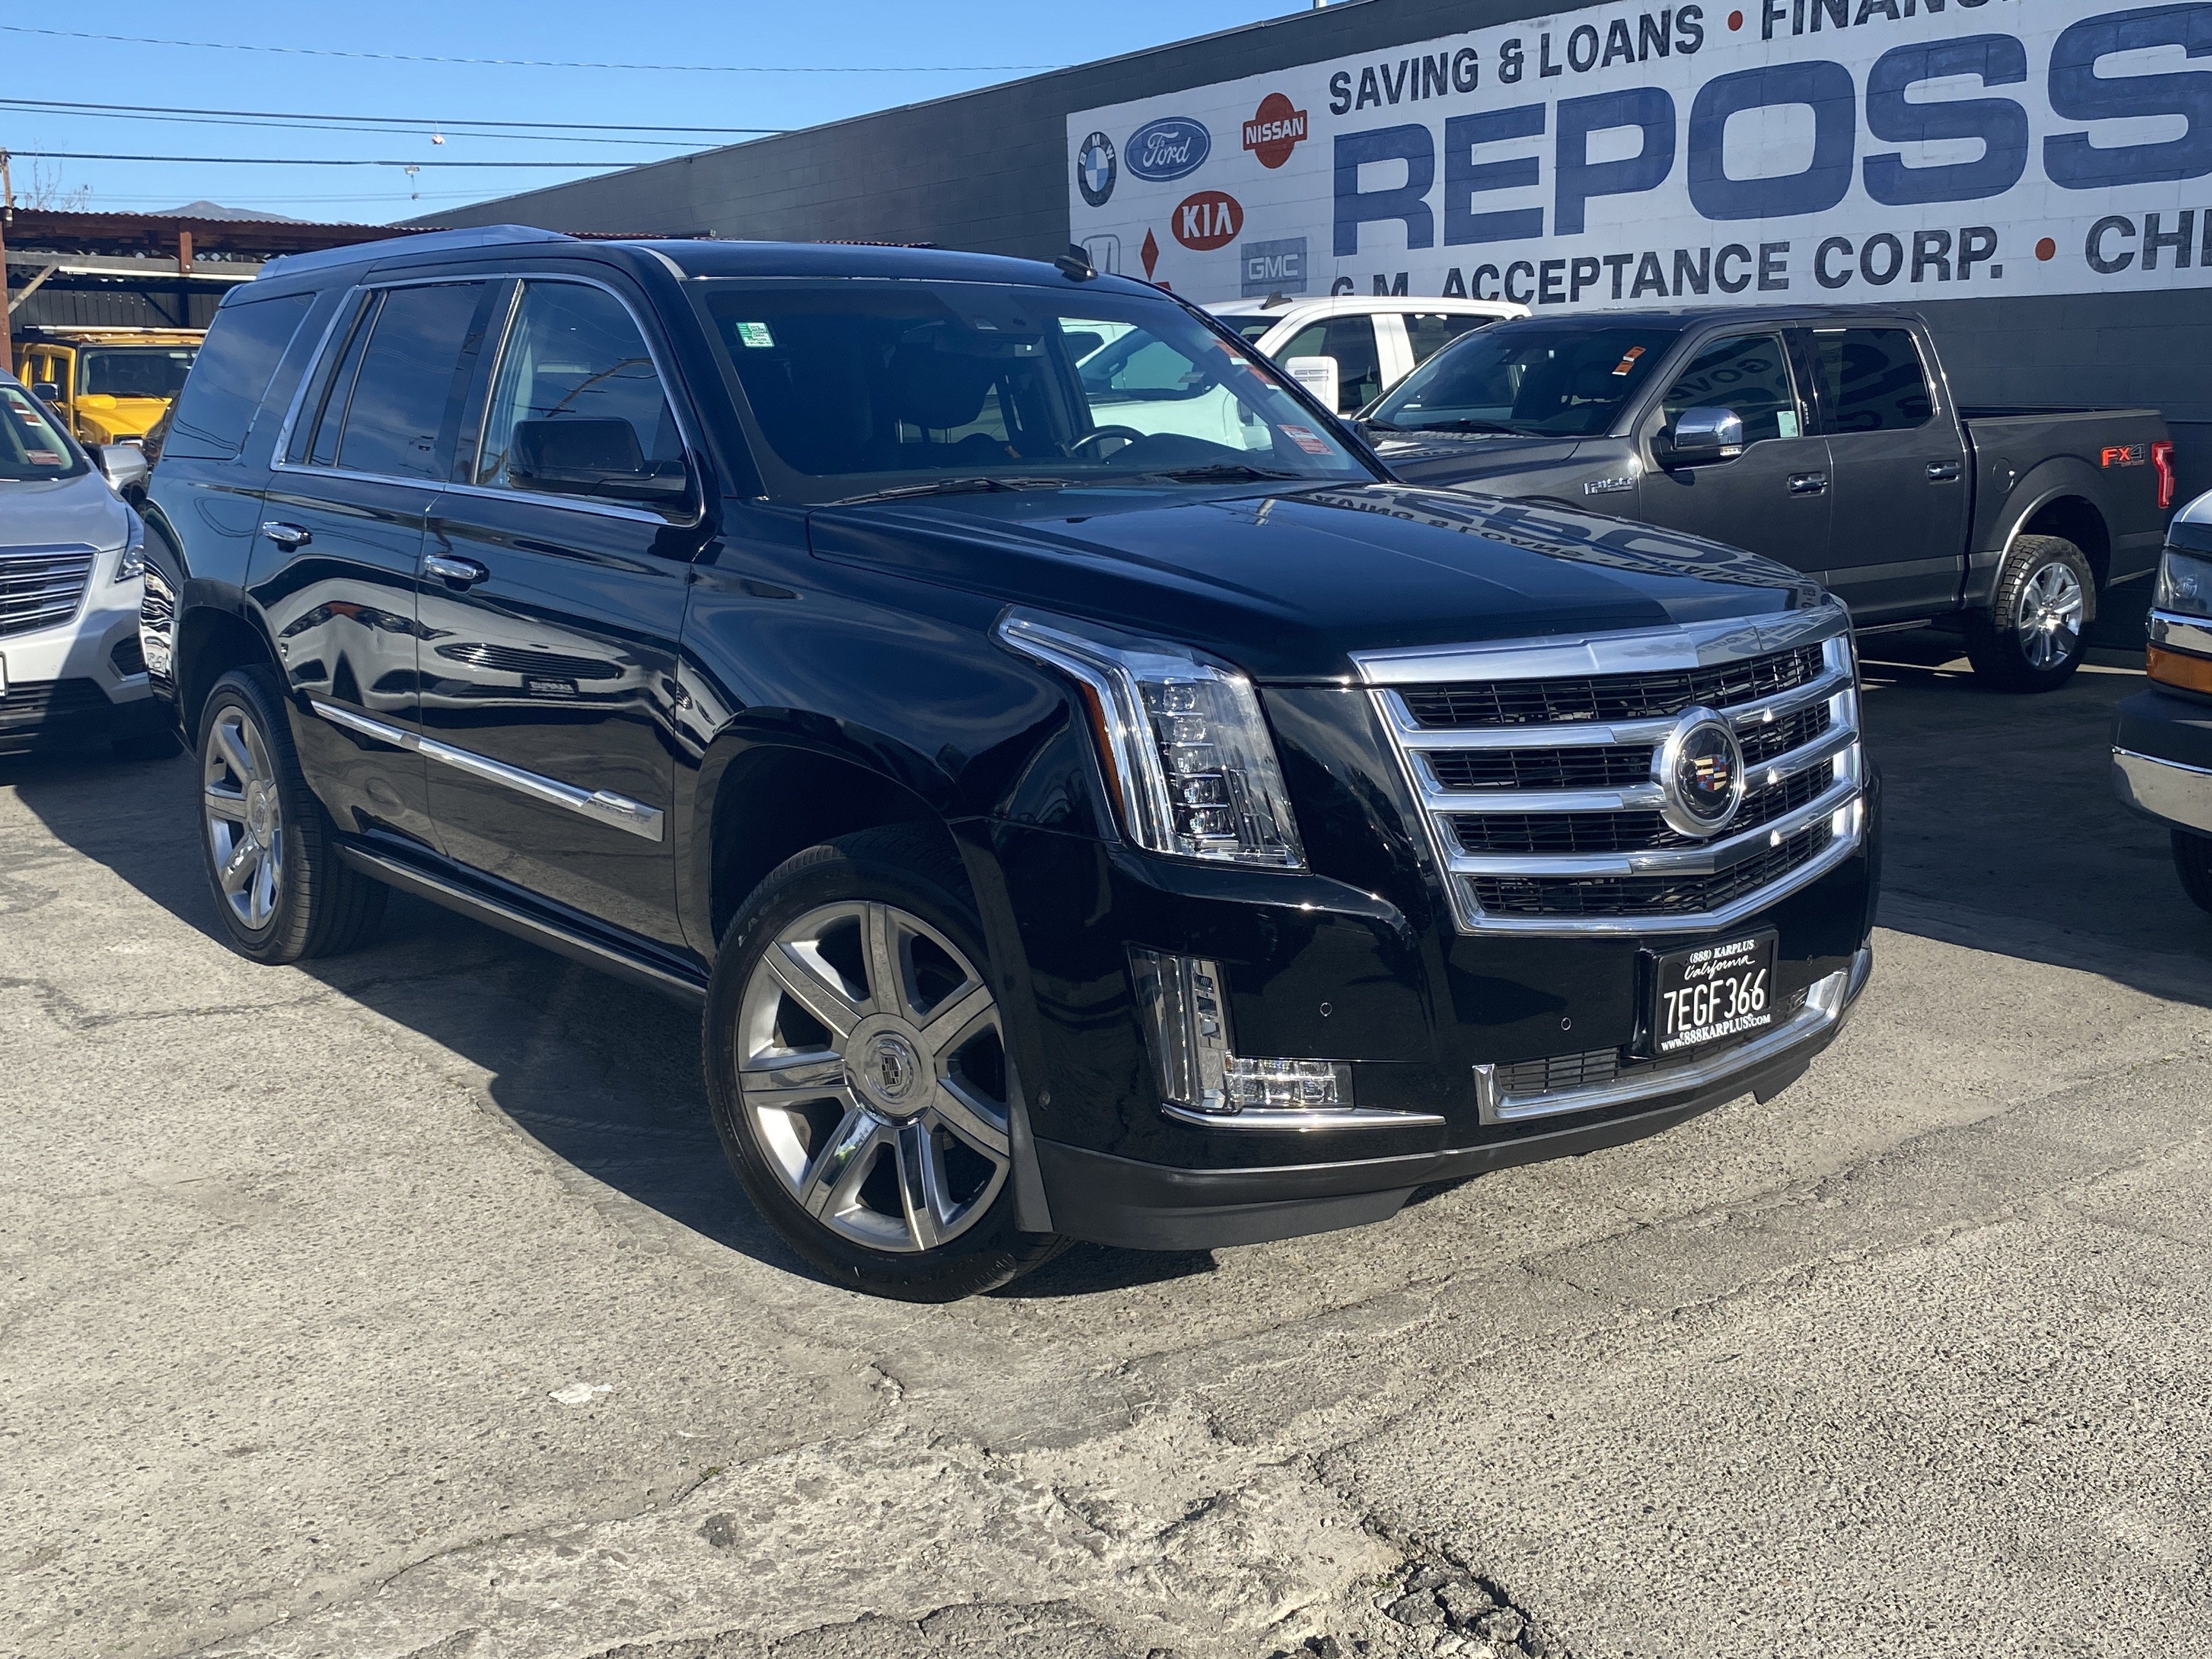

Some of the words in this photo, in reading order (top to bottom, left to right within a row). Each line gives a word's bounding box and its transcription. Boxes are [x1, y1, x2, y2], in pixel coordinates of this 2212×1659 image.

[1329, 47, 1479, 116] SAVING
[1498, 38, 1525, 84] &
[1539, 4, 1704, 78] LOANS
[1762, 0, 1983, 40] FINA
[1246, 117, 1304, 145] NISSAN
[1333, 2, 2212, 257] REPOSS
[1079, 133, 1115, 166] BMW
[1143, 132, 1191, 167] Ford
[1182, 201, 1233, 239] KIA
[1248, 254, 1298, 280] GMC
[1442, 241, 1790, 305] ACCEPTANCE
[1814, 227, 2003, 289] CORP.
[2085, 209, 2212, 274] CH
[2100, 443, 2146, 469] FX4
[1684, 955, 1756, 980] California
[1690, 950, 1712, 964] (888)
[1713, 939, 1755, 958] KARPLUS
[1663, 968, 1766, 1034] 7EGF366
